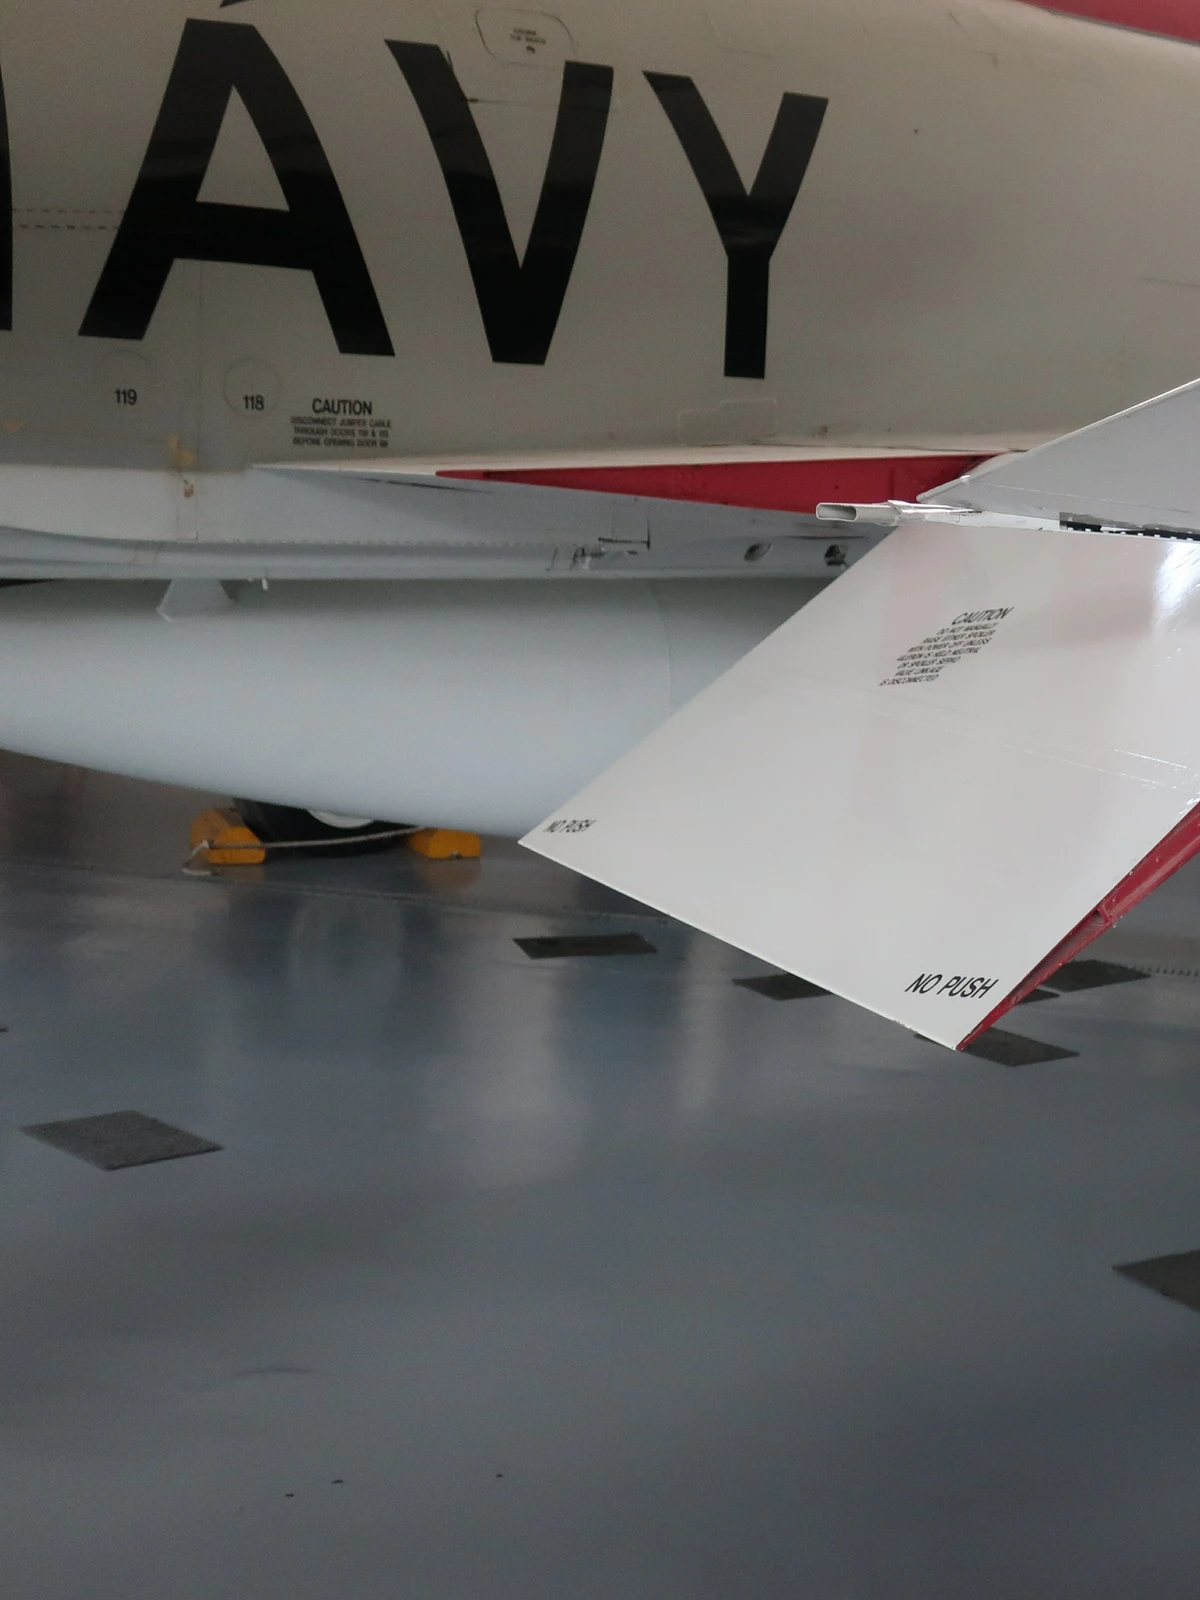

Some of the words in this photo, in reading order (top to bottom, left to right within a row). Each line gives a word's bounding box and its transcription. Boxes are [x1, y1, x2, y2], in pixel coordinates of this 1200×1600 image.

[0, 18, 829, 380] AVY
[114, 388, 137, 406] 119
[243, 394, 265, 411] 118
[312, 398, 373, 415] CAUTION
[951, 606, 1014, 625] CAUTION
[542, 819, 566, 833] NO
[559, 819, 597, 833] PUSH
[904, 973, 943, 994] NO
[936, 976, 1000, 999] PUSH
